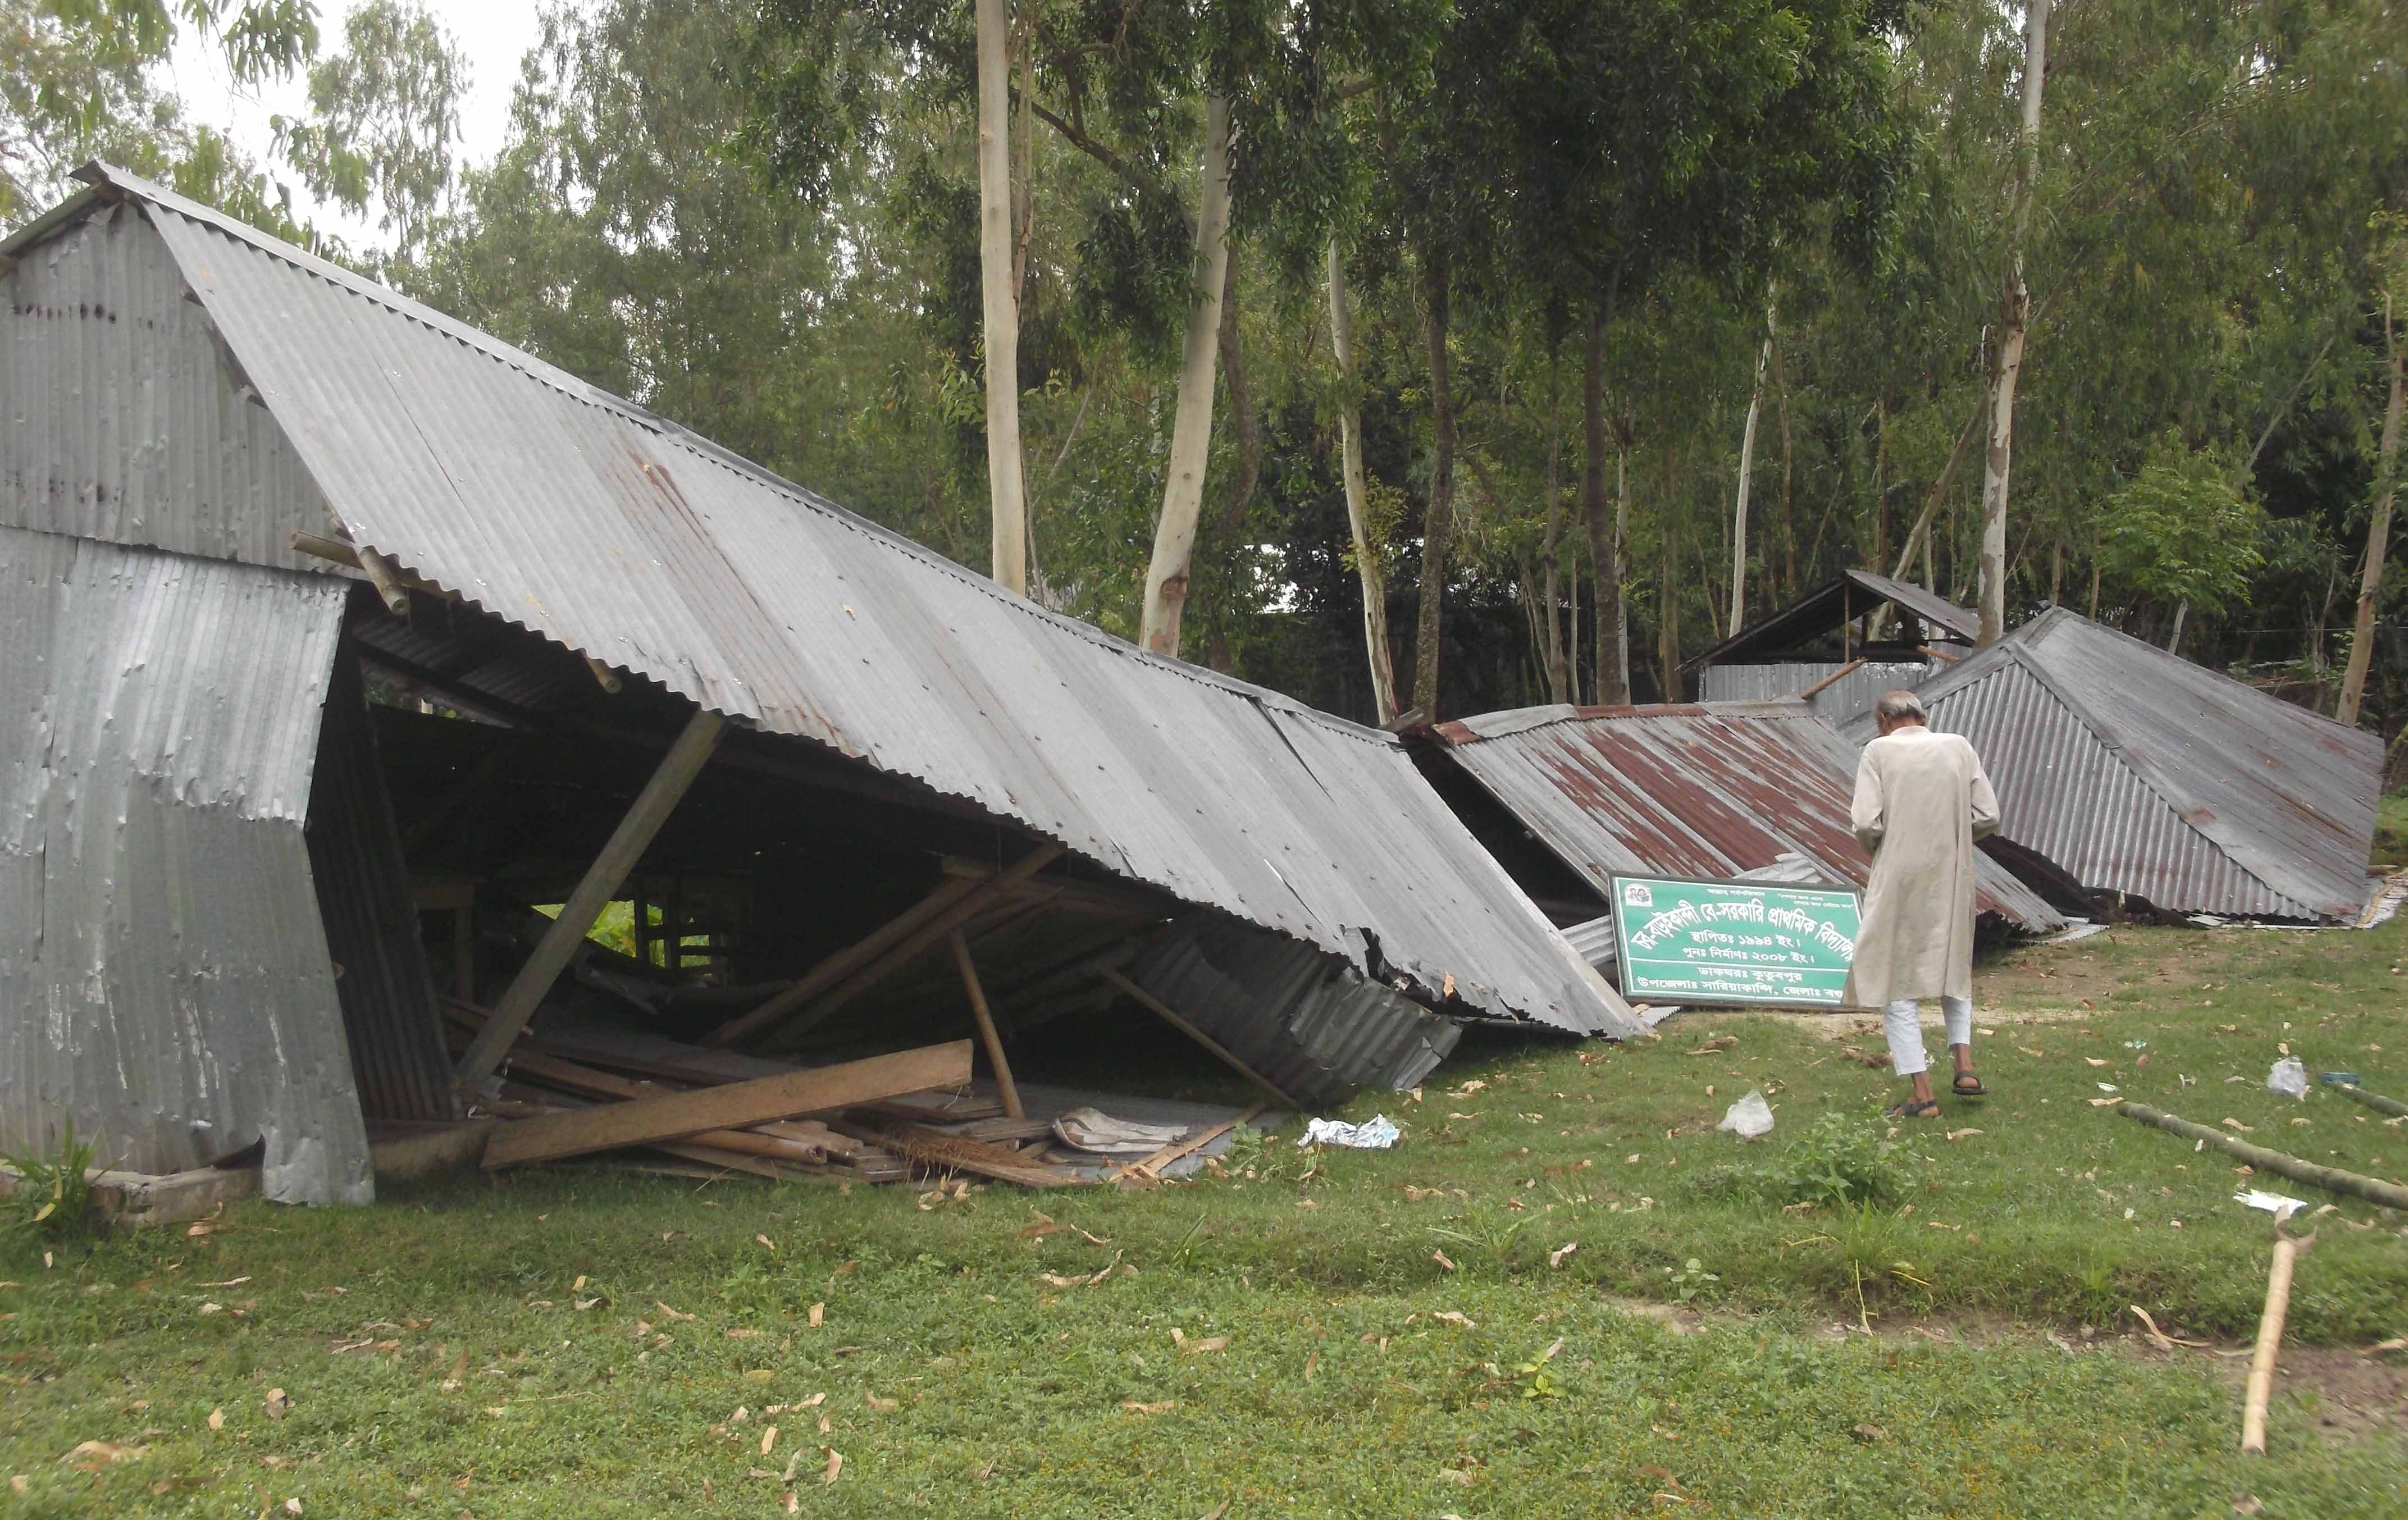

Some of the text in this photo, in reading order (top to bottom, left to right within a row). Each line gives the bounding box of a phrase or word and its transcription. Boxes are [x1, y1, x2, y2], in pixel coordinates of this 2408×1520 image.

[1701, 898, 1764, 924] বে-সরকারি
[1768, 907, 1817, 934] প্রাথমিক
[1739, 935, 1772, 946] ১৯৯৪
[1752, 952, 1787, 962] ২০০৮
[1751, 969, 1803, 983] কুতুবপুর
